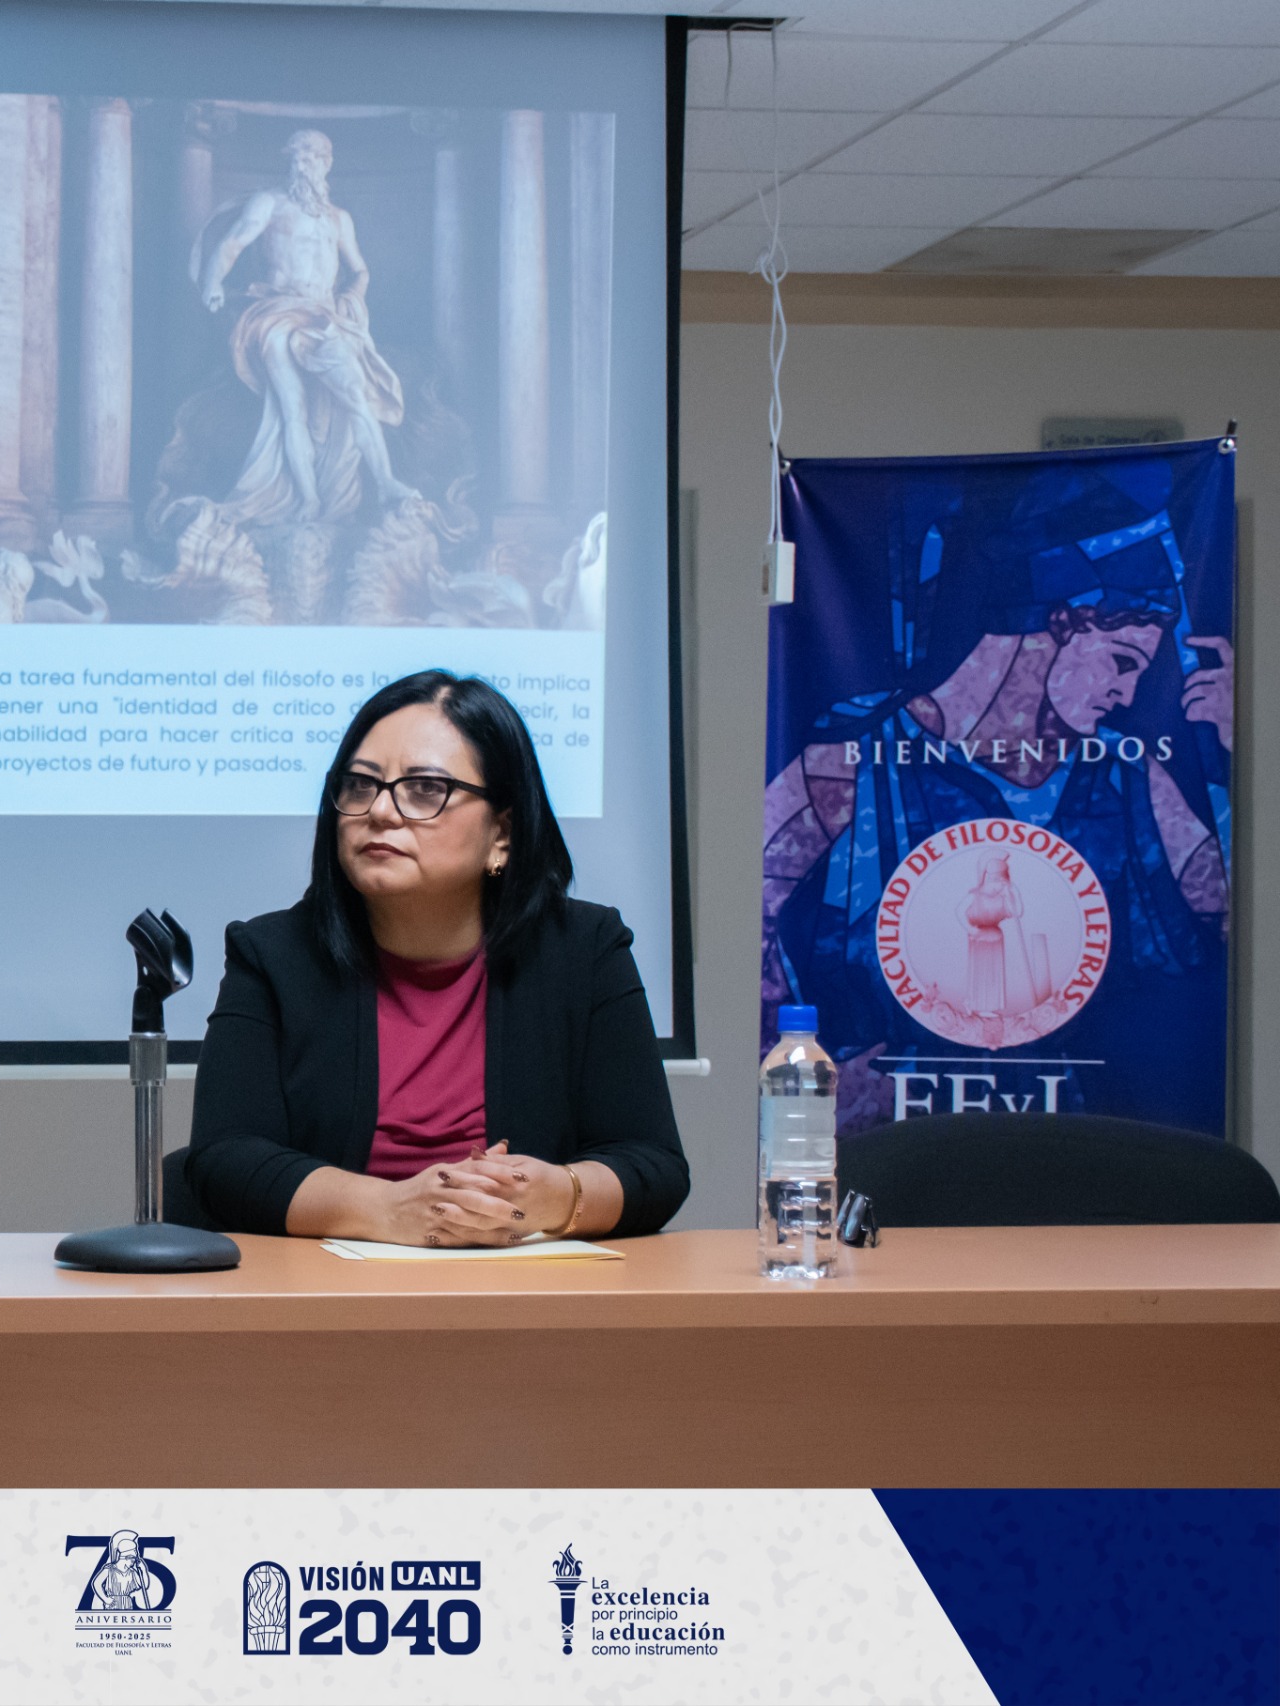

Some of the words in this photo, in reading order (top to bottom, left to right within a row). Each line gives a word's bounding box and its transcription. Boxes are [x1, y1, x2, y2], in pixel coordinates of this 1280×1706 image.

[19, 671, 75, 686] tarea
[82, 669, 217, 686] fundamental
[224, 670, 254, 686] del
[262, 669, 334, 688] filósofo
[342, 676, 364, 688] es
[372, 672, 389, 688] la
[518, 675, 590, 698] implica
[58, 700, 98, 714] una
[114, 698, 217, 716] "identidad
[232, 699, 258, 716] de
[273, 698, 335, 716] crítico
[520, 704, 558, 722] ecir,
[572, 704, 590, 720] la
[99, 729, 148, 748] para
[160, 726, 218, 744] hacer
[230, 726, 295, 744] crítica
[564, 730, 590, 748] de
[844, 735, 1173, 766] BIENVENIDOS
[98, 755, 122, 772] de
[130, 755, 190, 773] futuro
[198, 759, 207, 776] y
[214, 756, 306, 776] pasados.
[906, 841, 943, 877] DE
[946, 820, 1085, 884] FILOSOFIA
[1077, 881, 1100, 899] Y
[878, 877, 924, 1010] FACVLTAD
[1064, 907, 1107, 1008] LETRAS
